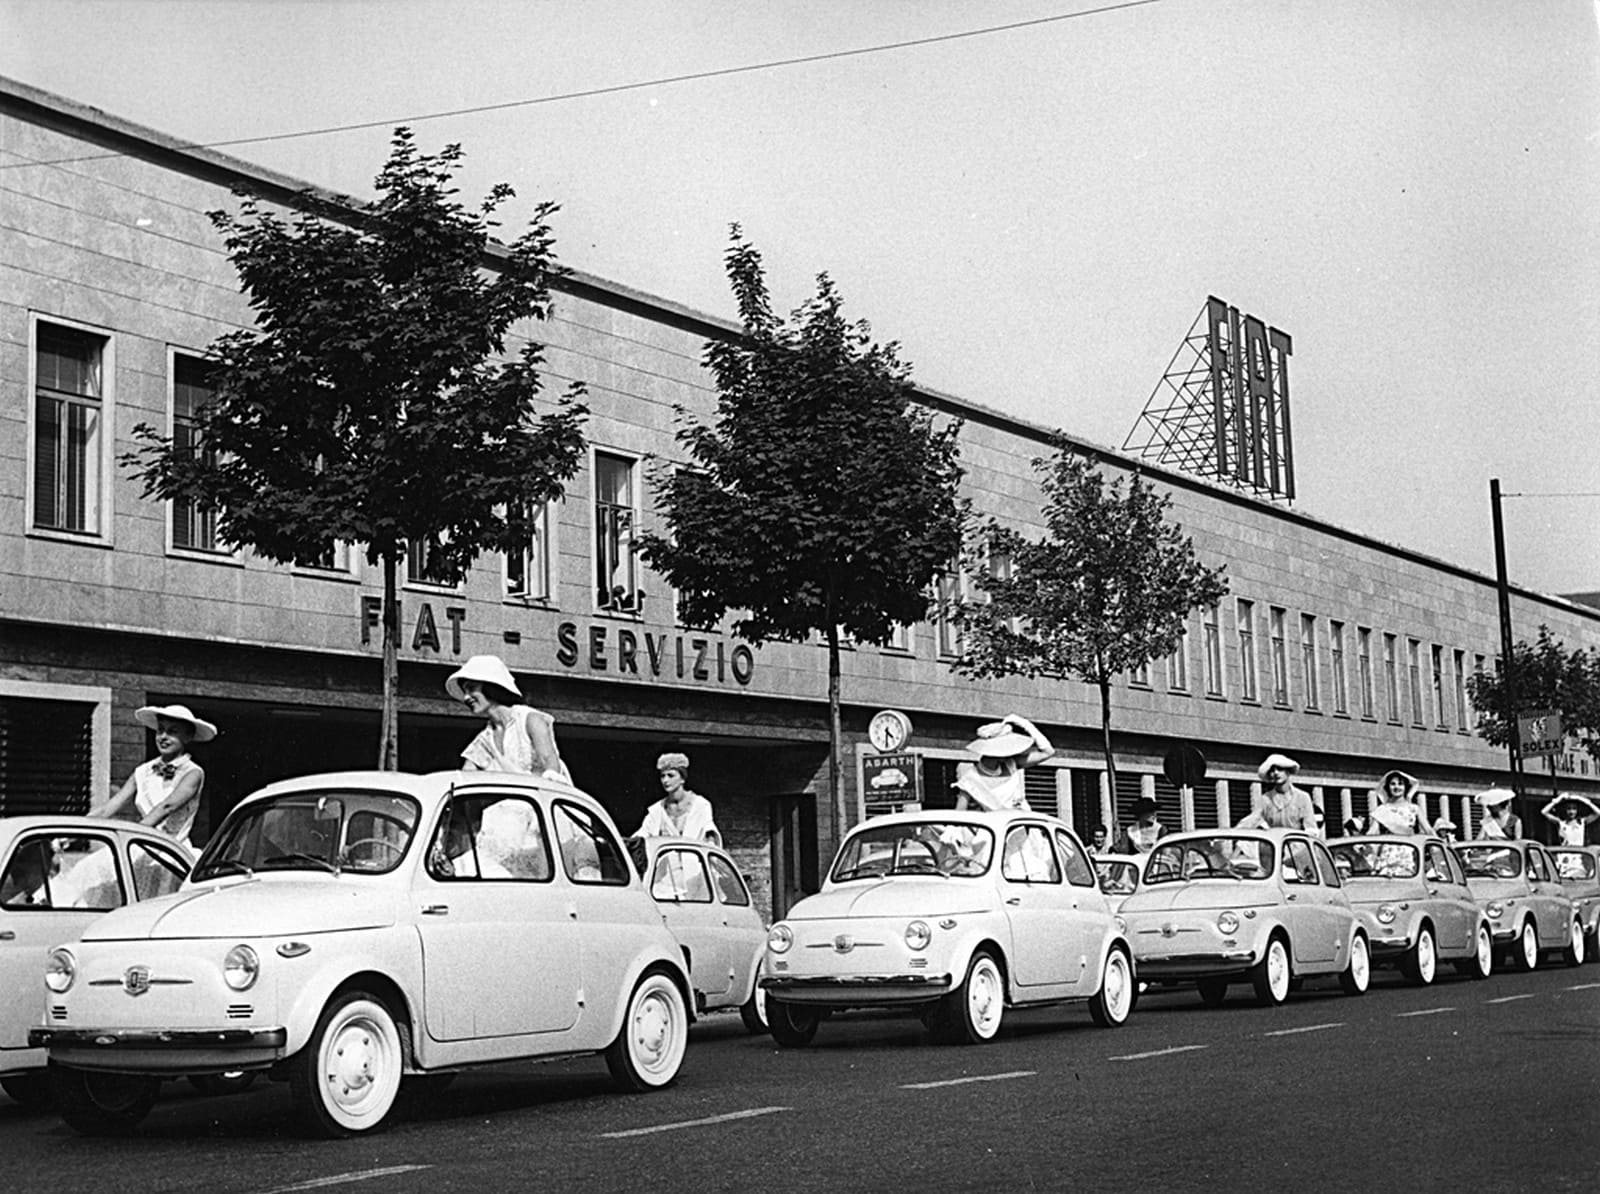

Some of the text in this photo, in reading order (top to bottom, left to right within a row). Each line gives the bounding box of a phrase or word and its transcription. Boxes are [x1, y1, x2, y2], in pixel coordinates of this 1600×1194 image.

[1208, 294, 1295, 500] FIAT
[361, 595, 466, 655] FIAT
[555, 621, 754, 686] SERVIZIO
[865, 757, 914, 769] ABARTH
[1522, 739, 1560, 752] SOLEX
